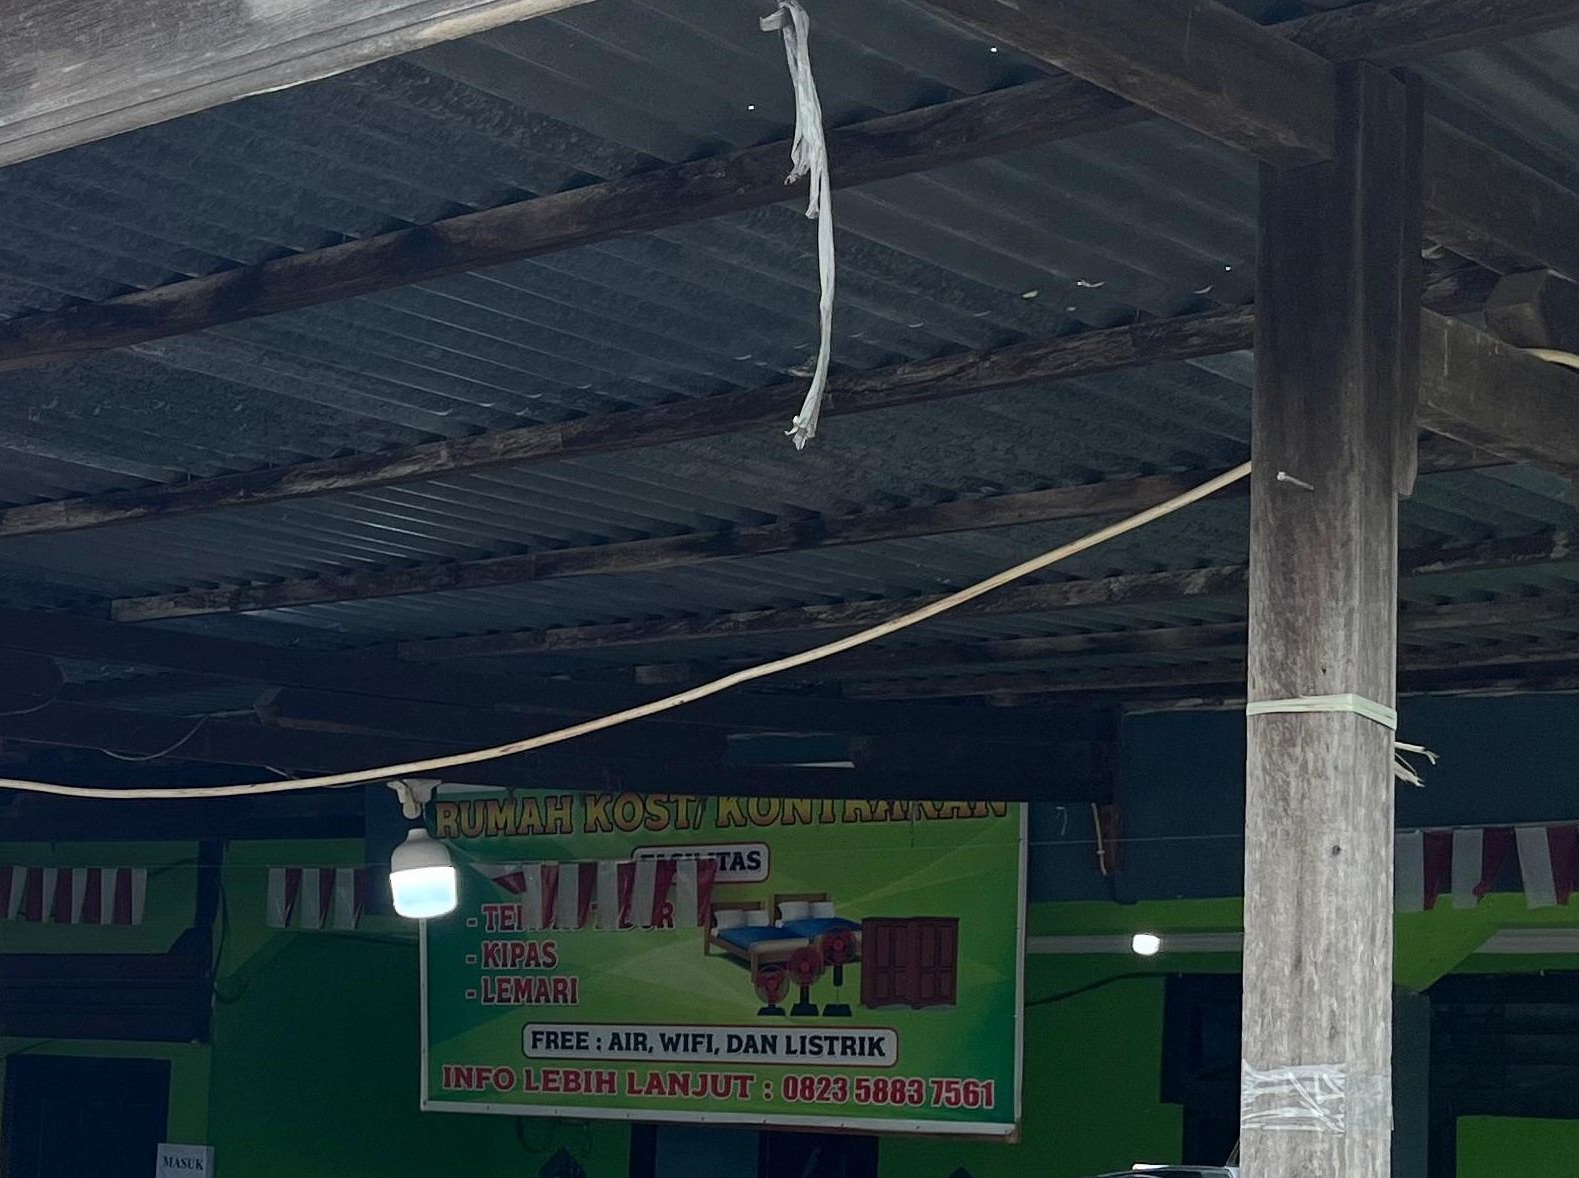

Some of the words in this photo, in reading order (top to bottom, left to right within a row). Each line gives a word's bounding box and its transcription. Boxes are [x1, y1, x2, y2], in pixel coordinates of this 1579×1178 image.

[434, 794, 574, 839] RUMAH
[481, 940, 559, 970] KIPAS
[480, 975, 580, 1005] LEMARI
[530, 1030, 590, 1051] FREE
[608, 1031, 654, 1055] AIR,
[659, 1032, 720, 1057] WIFI,
[726, 1033, 778, 1054] DAN
[784, 1034, 887, 1058] LISTRIK
[442, 1065, 516, 1091] INFO
[523, 1068, 618, 1095] LEBIH
[626, 1071, 755, 1099] LANJUT
[781, 1074, 849, 1104] 0823
[854, 1076, 924, 1106] 5883
[929, 1079, 996, 1108] 7561
[163, 1154, 205, 1172] MASUK
